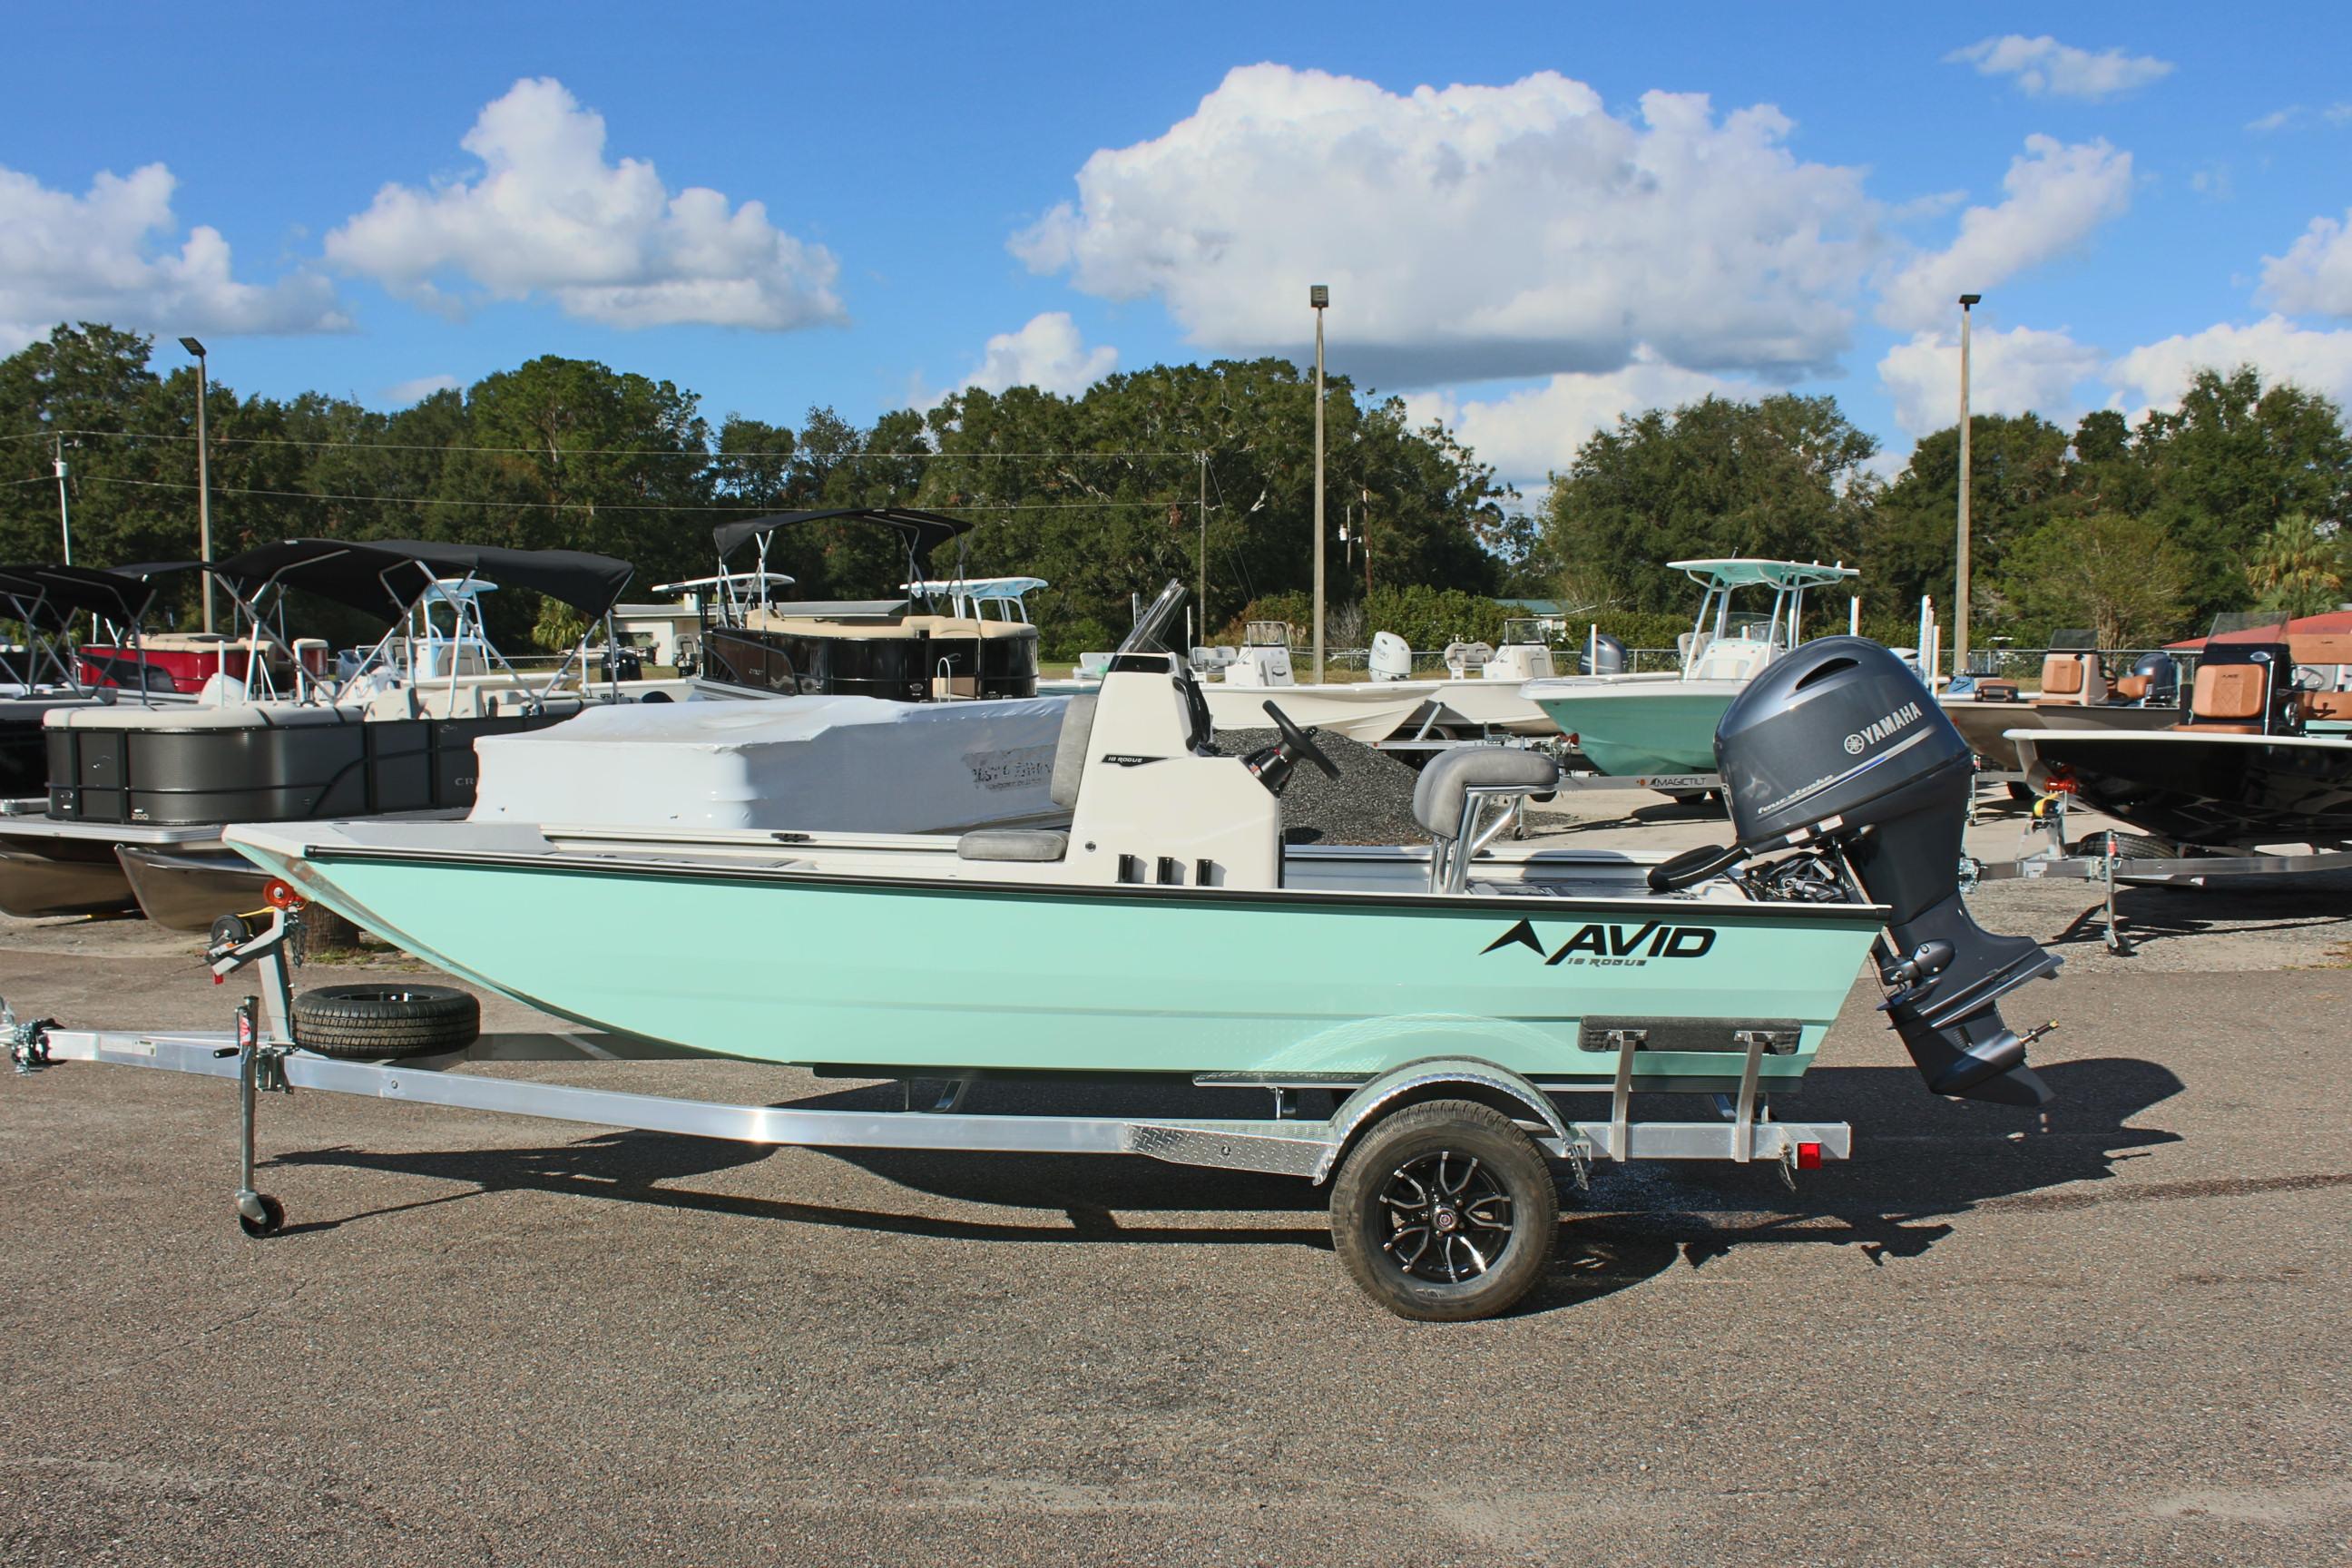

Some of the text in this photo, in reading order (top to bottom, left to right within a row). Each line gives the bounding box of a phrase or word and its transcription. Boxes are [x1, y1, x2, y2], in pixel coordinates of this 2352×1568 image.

[1860, 701, 1923, 745] YAMAHA
[1544, 920, 1717, 965] AVID
[1588, 958, 1648, 967] ROGUE
